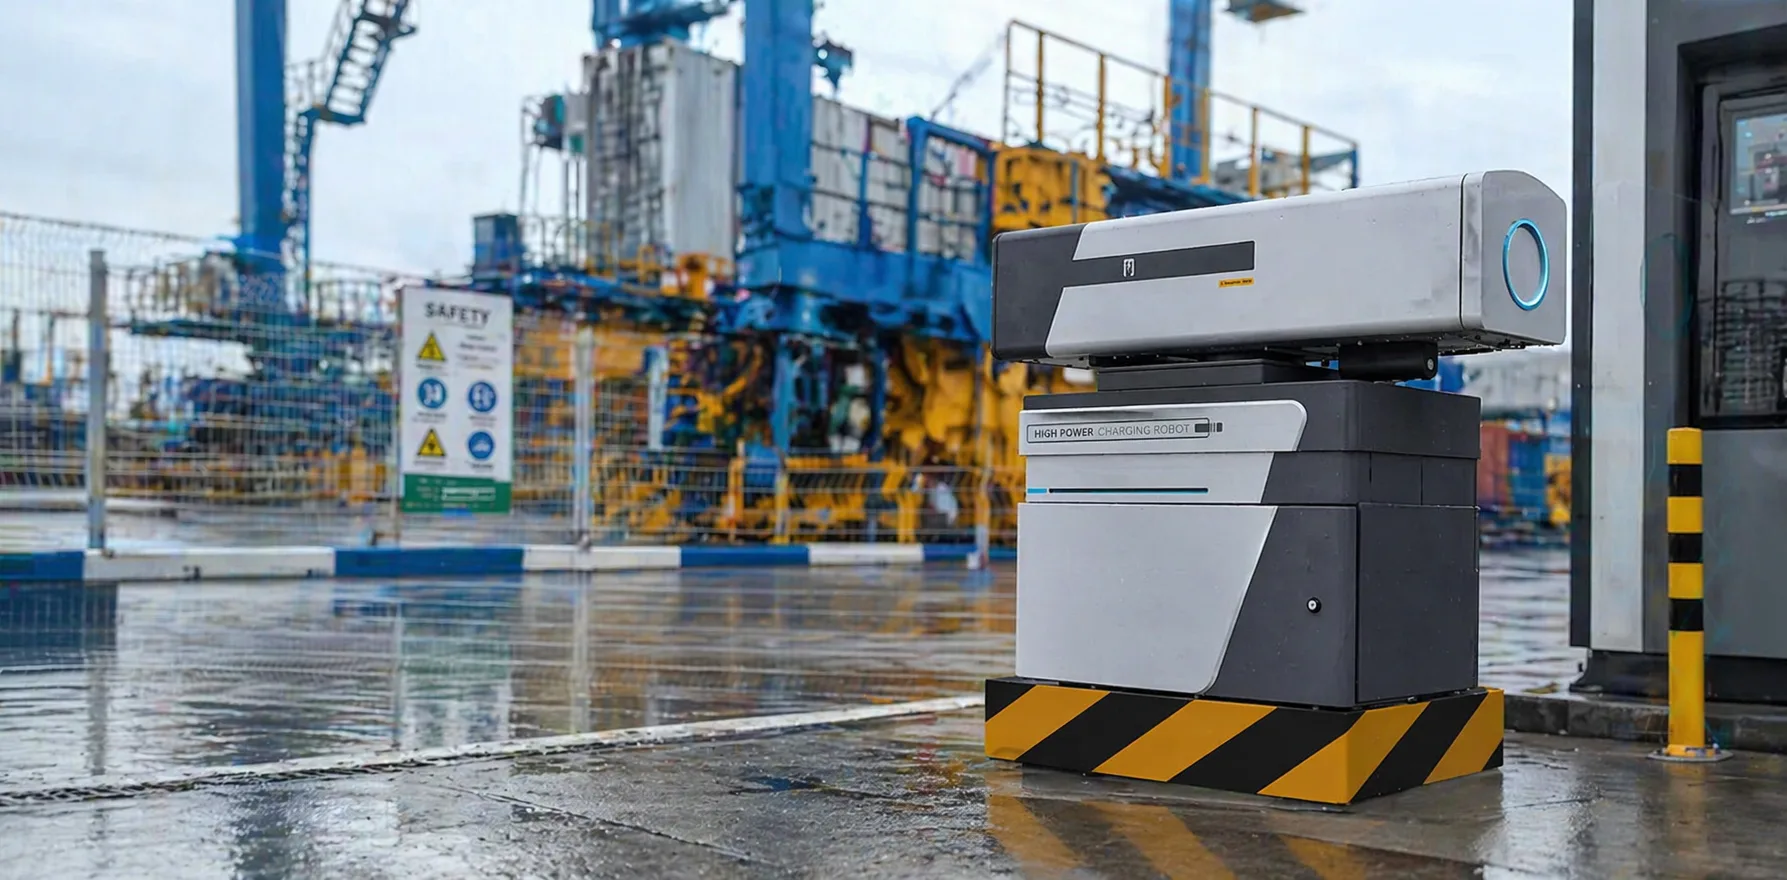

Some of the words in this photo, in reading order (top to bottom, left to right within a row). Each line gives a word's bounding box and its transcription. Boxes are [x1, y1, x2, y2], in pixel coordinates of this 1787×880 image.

[425, 302, 491, 325] SAFETY
[1034, 428, 1058, 439] HIGH
[1060, 427, 1094, 438] POWER
[1097, 425, 1151, 437] CHARGING
[1154, 423, 1190, 435] ROBOT
